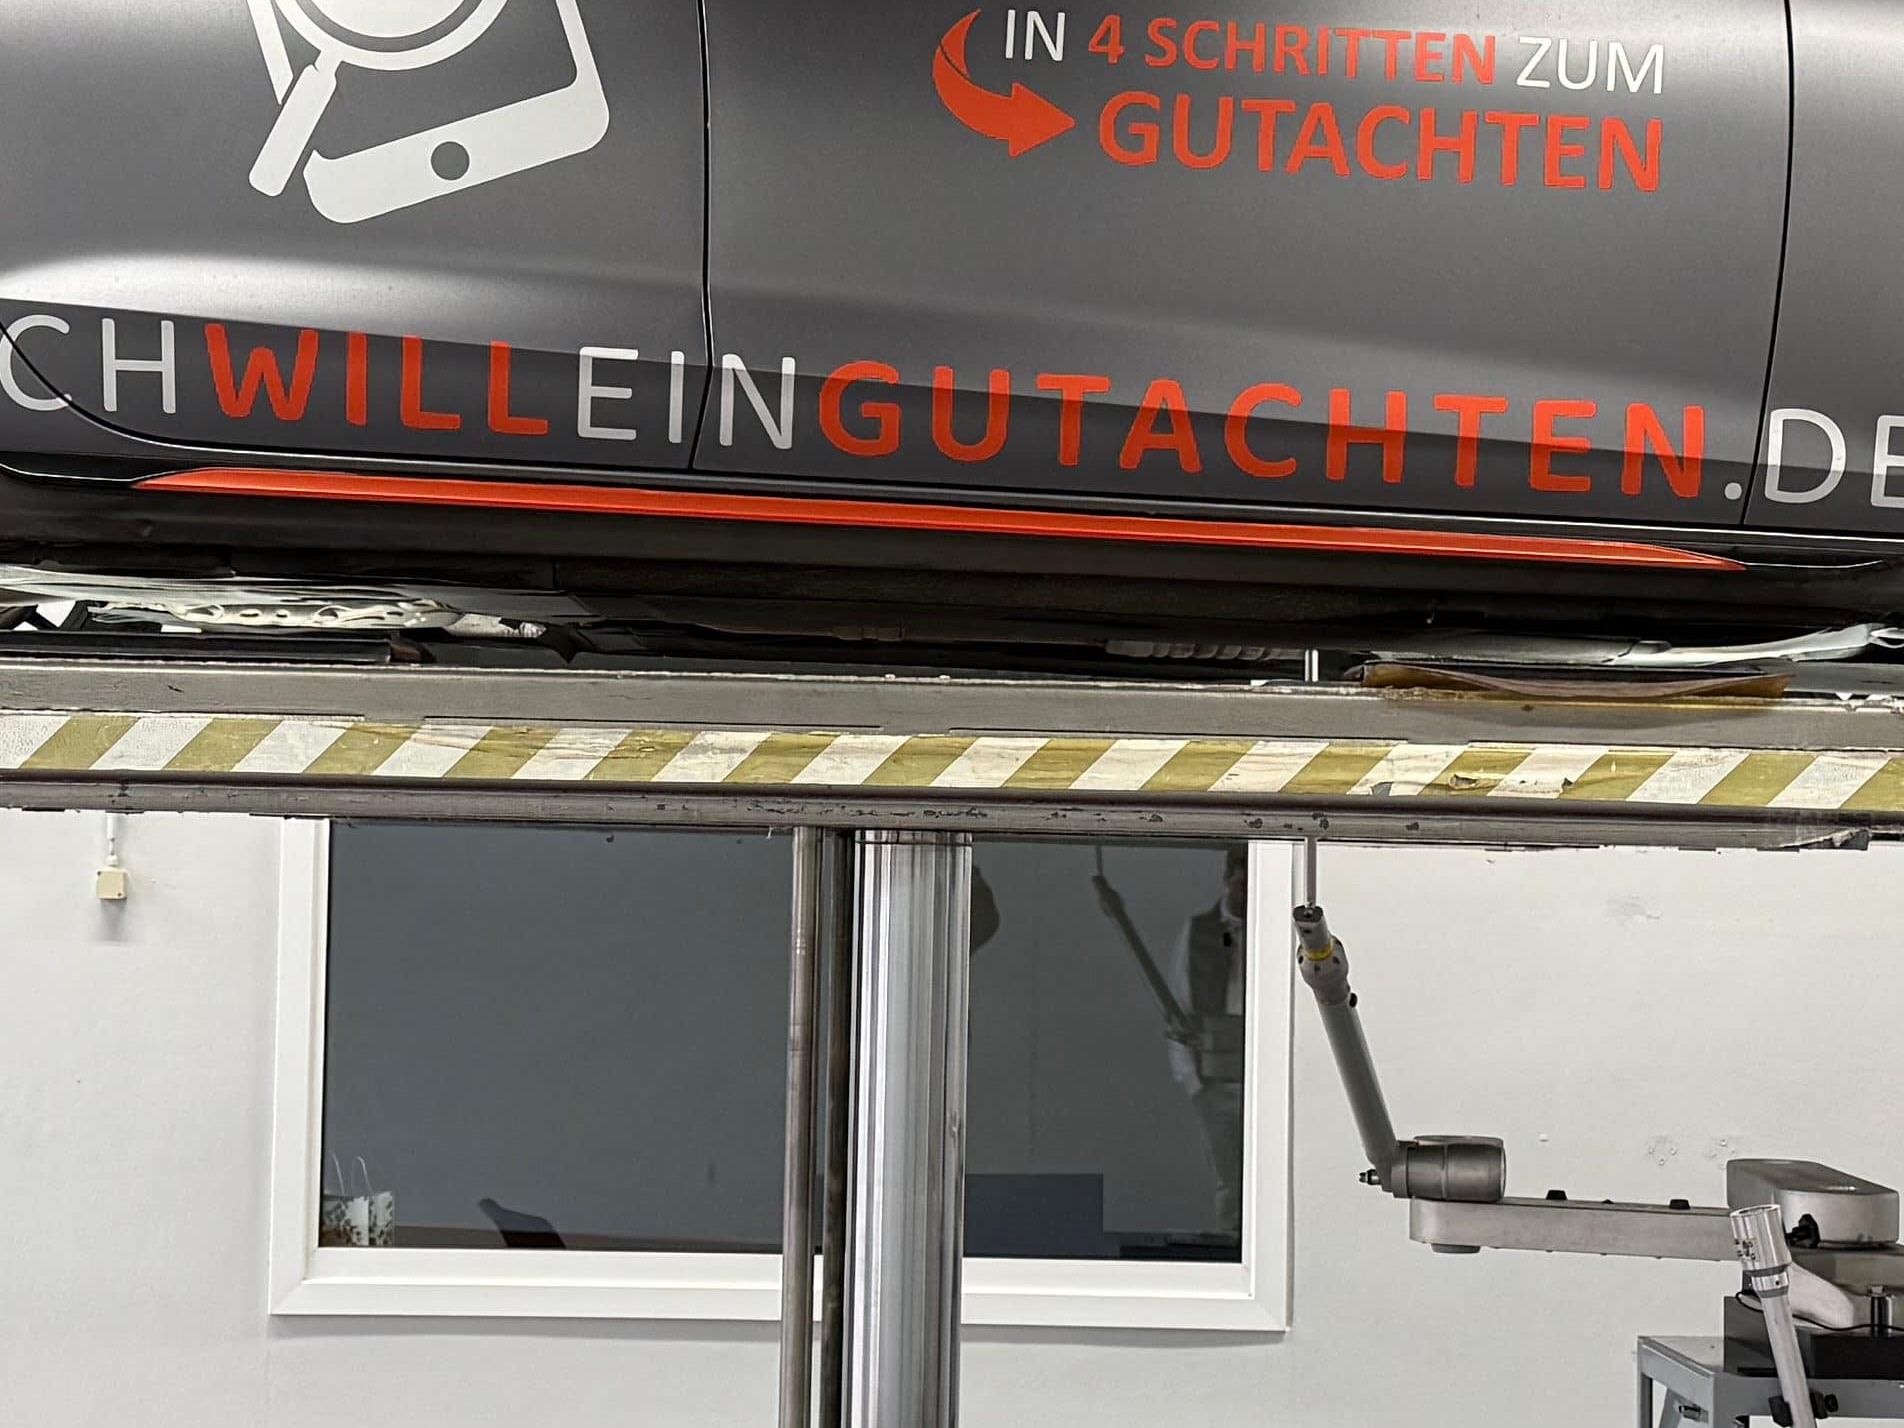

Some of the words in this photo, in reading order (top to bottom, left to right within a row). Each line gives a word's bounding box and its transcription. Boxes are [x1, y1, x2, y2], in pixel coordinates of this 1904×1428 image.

[1004, 8, 1066, 62] IN
[1088, 14, 1125, 64] 4
[1144, 17, 1496, 85] SCHRITTEN
[1515, 35, 1665, 95] ZUM
[1099, 90, 1663, 193] GUTACHTEN
